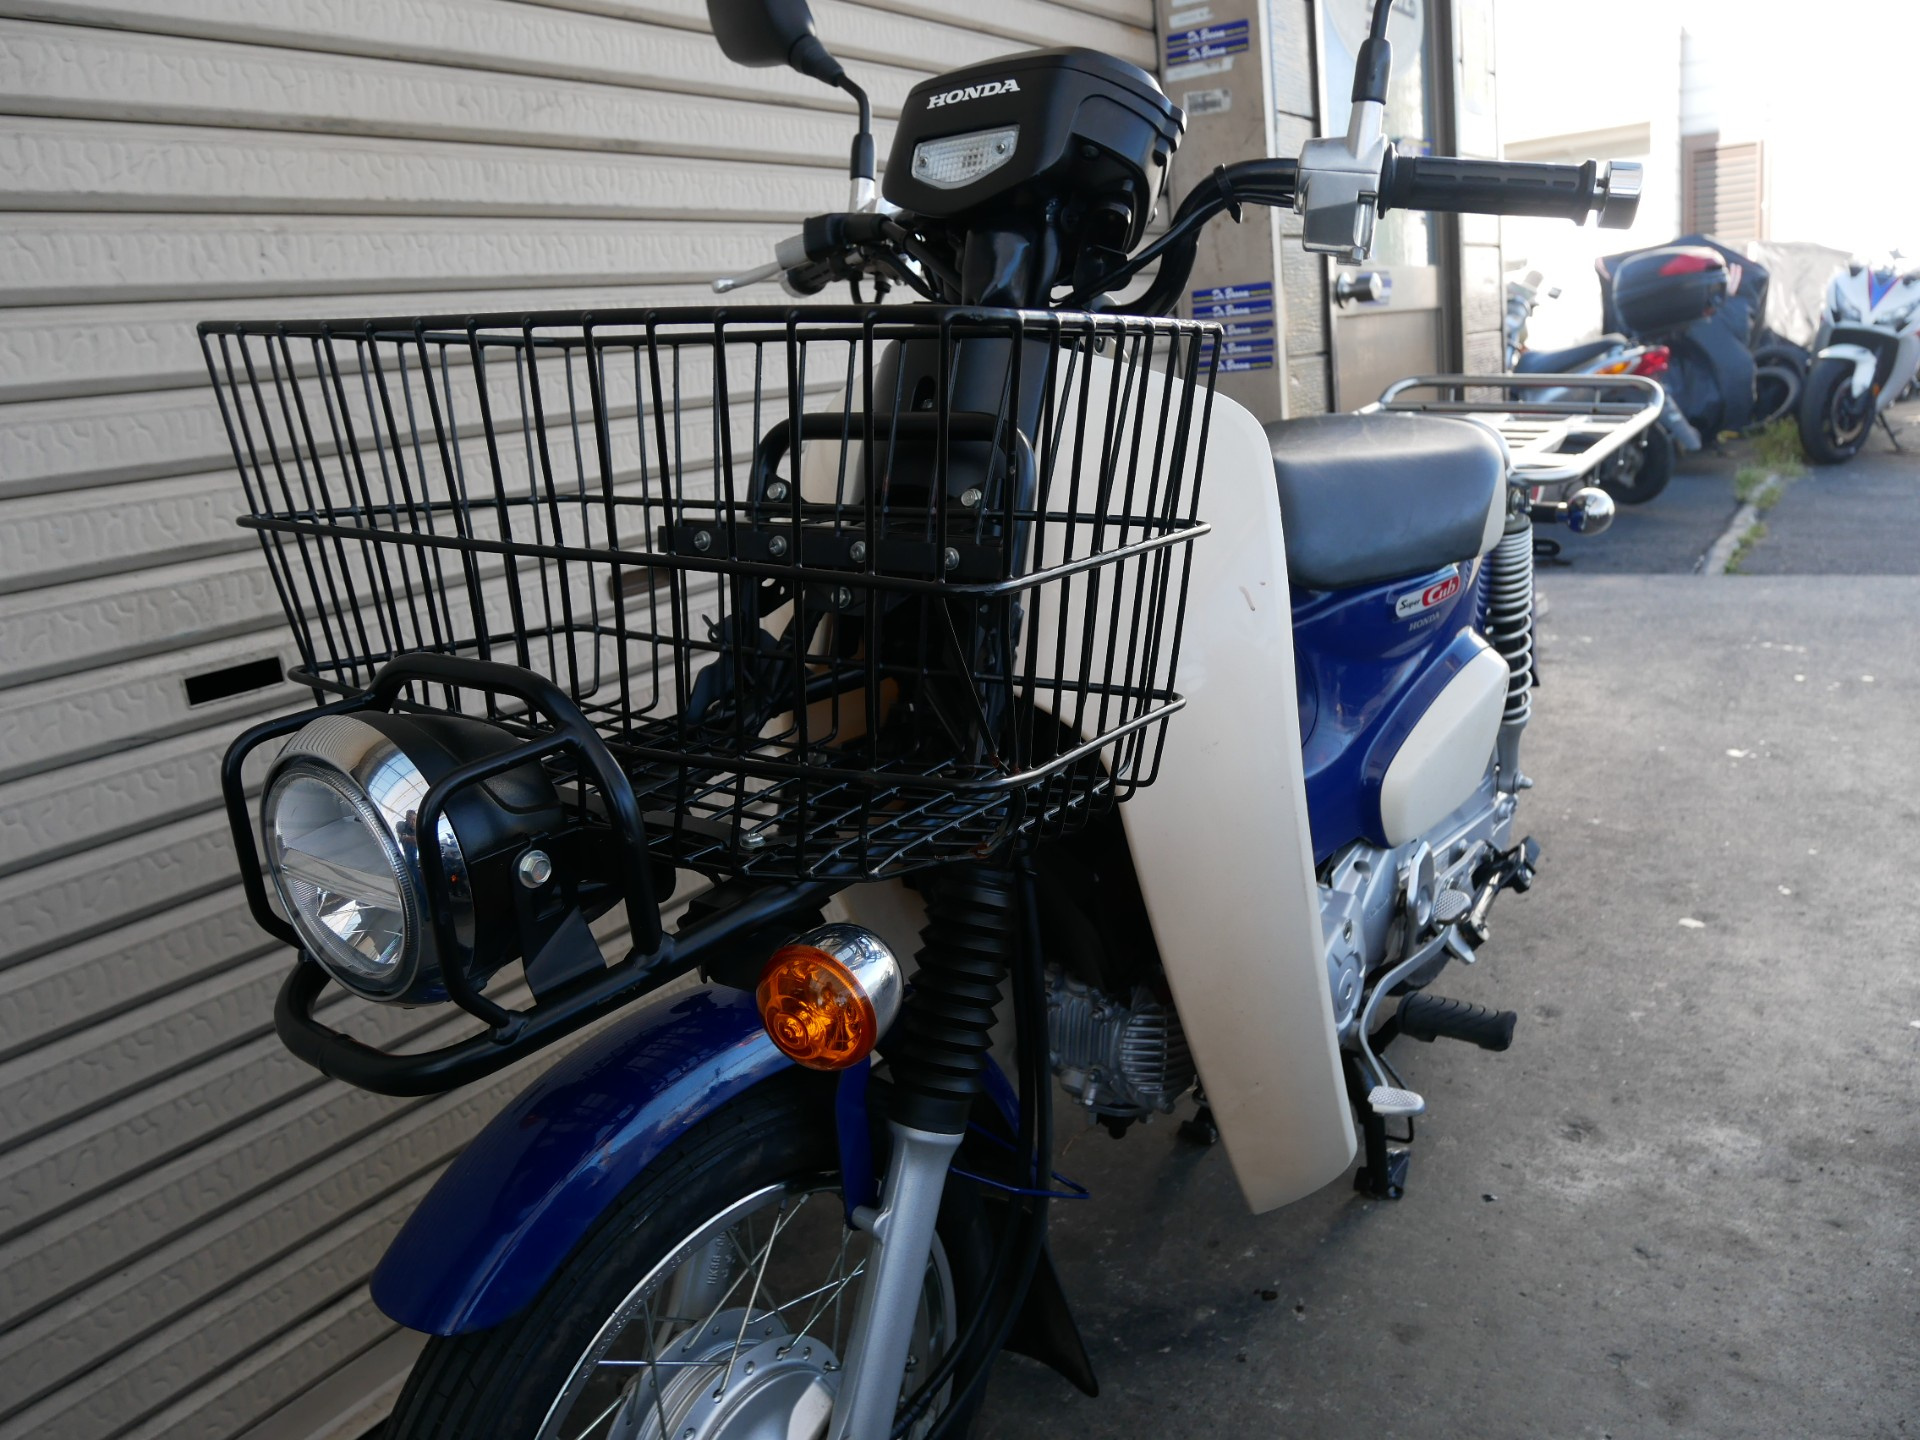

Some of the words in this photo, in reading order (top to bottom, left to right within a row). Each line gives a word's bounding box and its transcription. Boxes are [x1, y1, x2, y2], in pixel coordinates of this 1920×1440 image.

[926, 79, 1021, 110] HONDA
[1399, 598, 1422, 612] Super
[1427, 579, 1457, 604] Cub
[1408, 611, 1441, 632] HONDA
